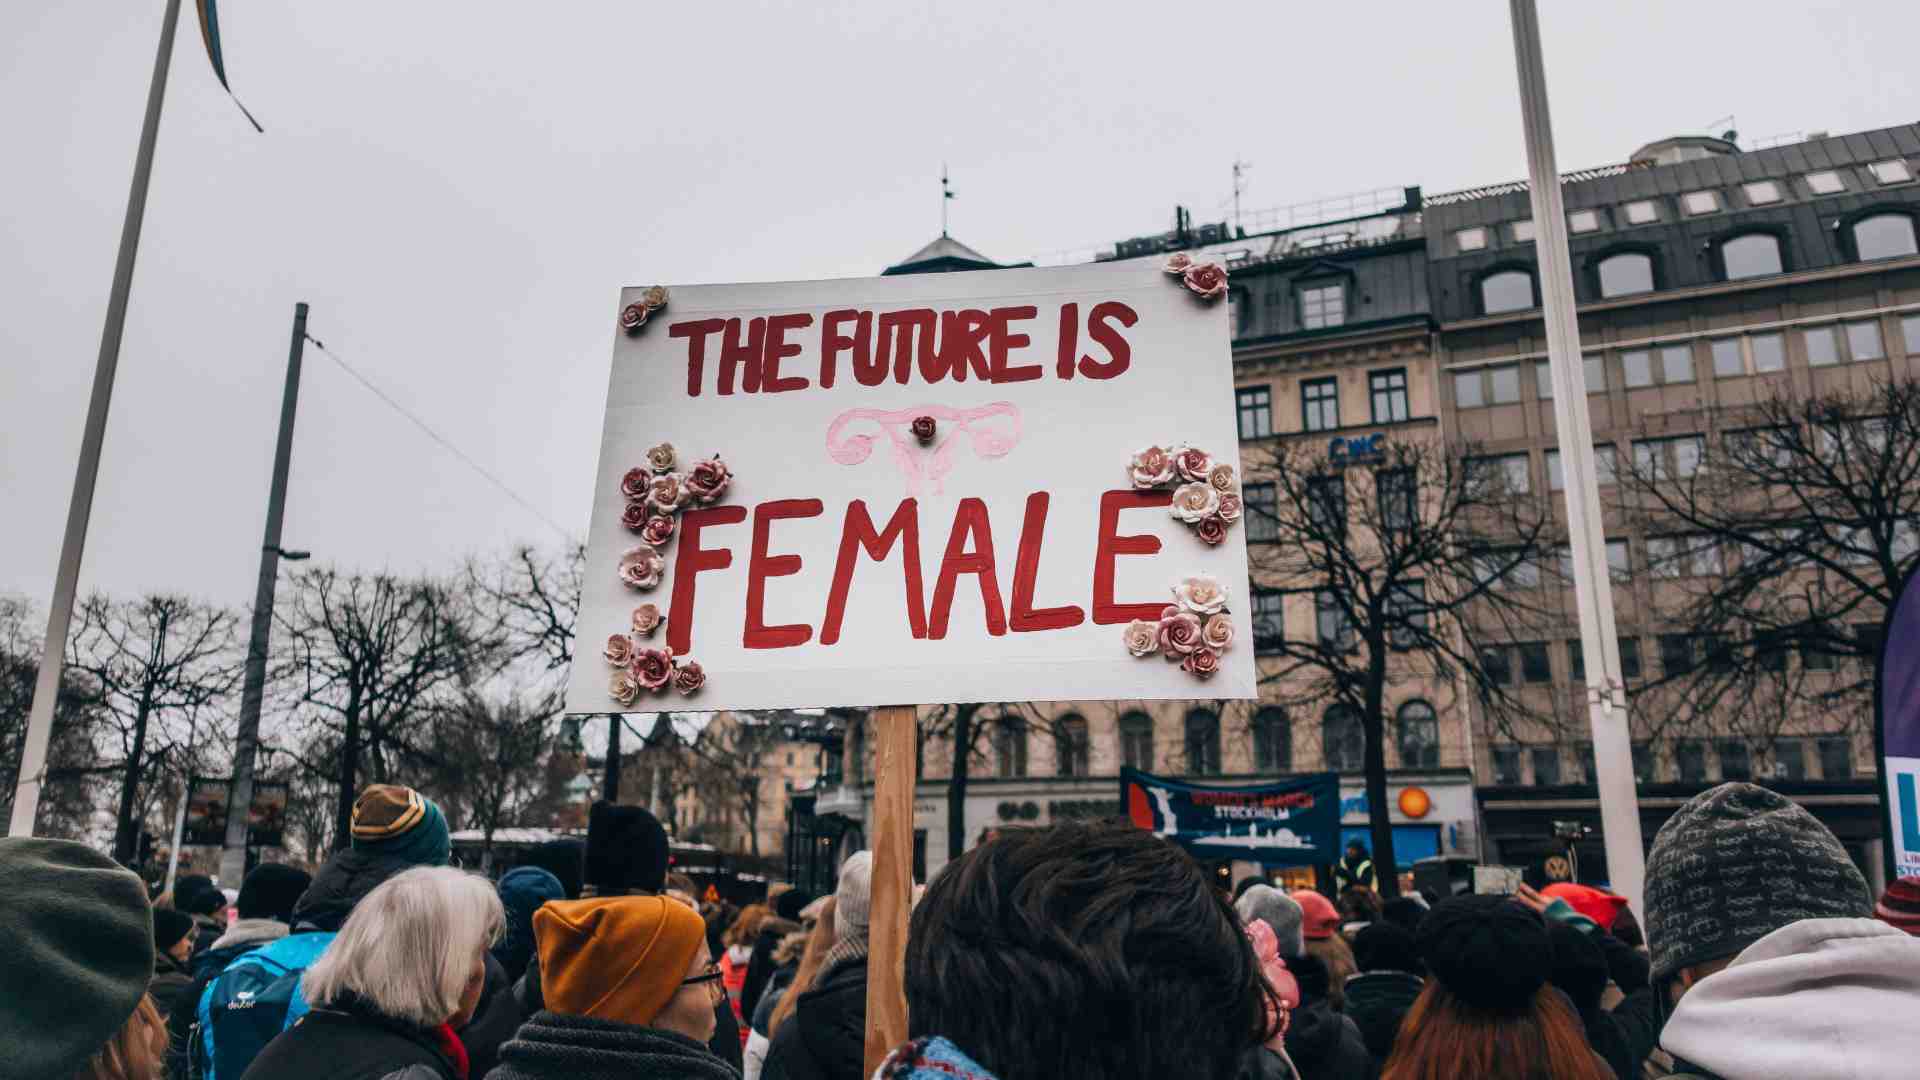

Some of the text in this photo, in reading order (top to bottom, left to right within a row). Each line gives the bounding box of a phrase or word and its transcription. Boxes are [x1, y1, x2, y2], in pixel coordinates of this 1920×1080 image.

[669, 301, 1138, 396] THE FUTURE IS
[665, 489, 1176, 656] FEMALE
